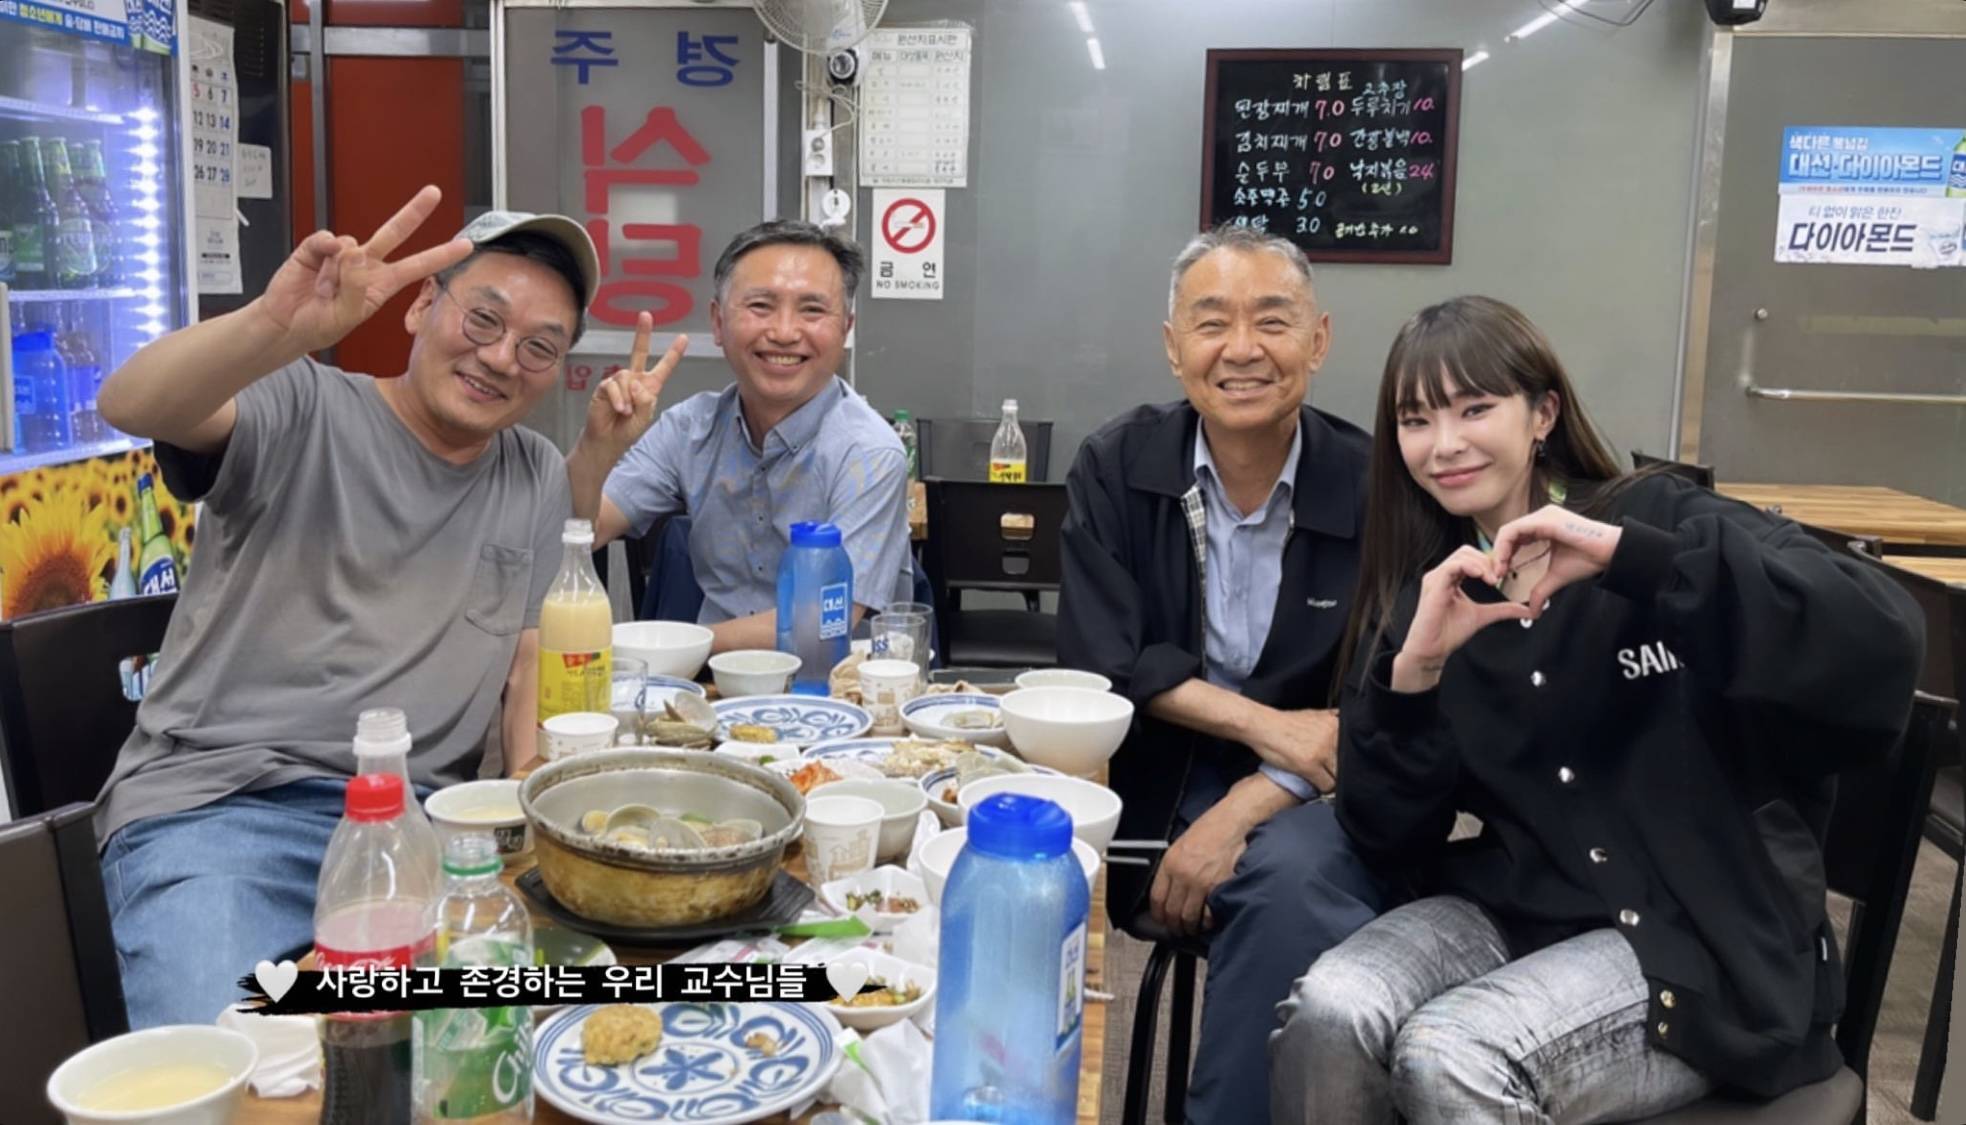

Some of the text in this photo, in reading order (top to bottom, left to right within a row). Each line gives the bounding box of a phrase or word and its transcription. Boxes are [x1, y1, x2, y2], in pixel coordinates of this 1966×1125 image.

[192, 81, 228, 103] 5 6 7
[193, 110, 230, 130] 12 13 14
[1234, 98, 1310, 120] 된장찌개
[193, 137, 204, 153] 19
[206, 139, 217, 155] 20
[220, 141, 230, 156] 21
[1235, 130, 1308, 153] 김치찌개
[194, 164, 205, 180] 26
[206, 165, 217, 181] 27
[1234, 160, 1290, 184] 순두부
[1788, 221, 1918, 253] 다이아몬드
[876, 280, 940, 290] NO SMOKING
